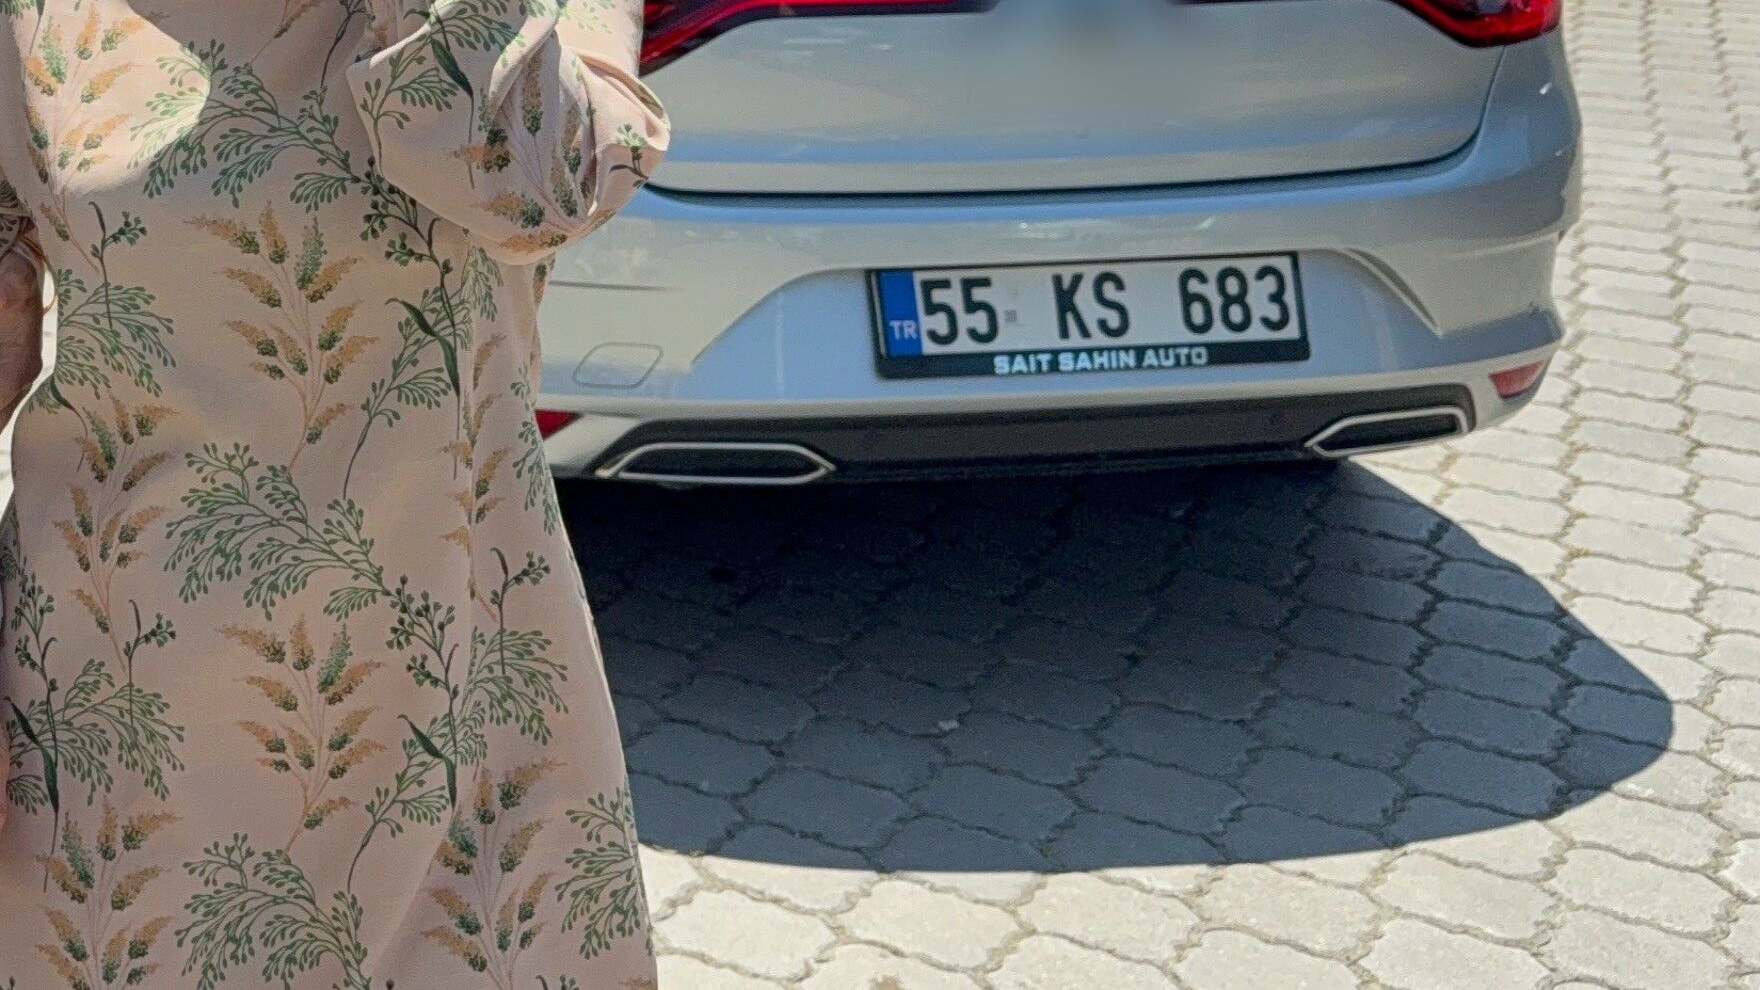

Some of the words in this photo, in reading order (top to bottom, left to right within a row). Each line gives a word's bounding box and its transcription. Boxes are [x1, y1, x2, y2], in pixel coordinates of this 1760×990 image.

[889, 320, 918, 340] TR
[921, 277, 998, 345] 55
[1052, 272, 1130, 339] KS
[1178, 265, 1289, 334] 683
[1142, 346, 1209, 366] AUTO
